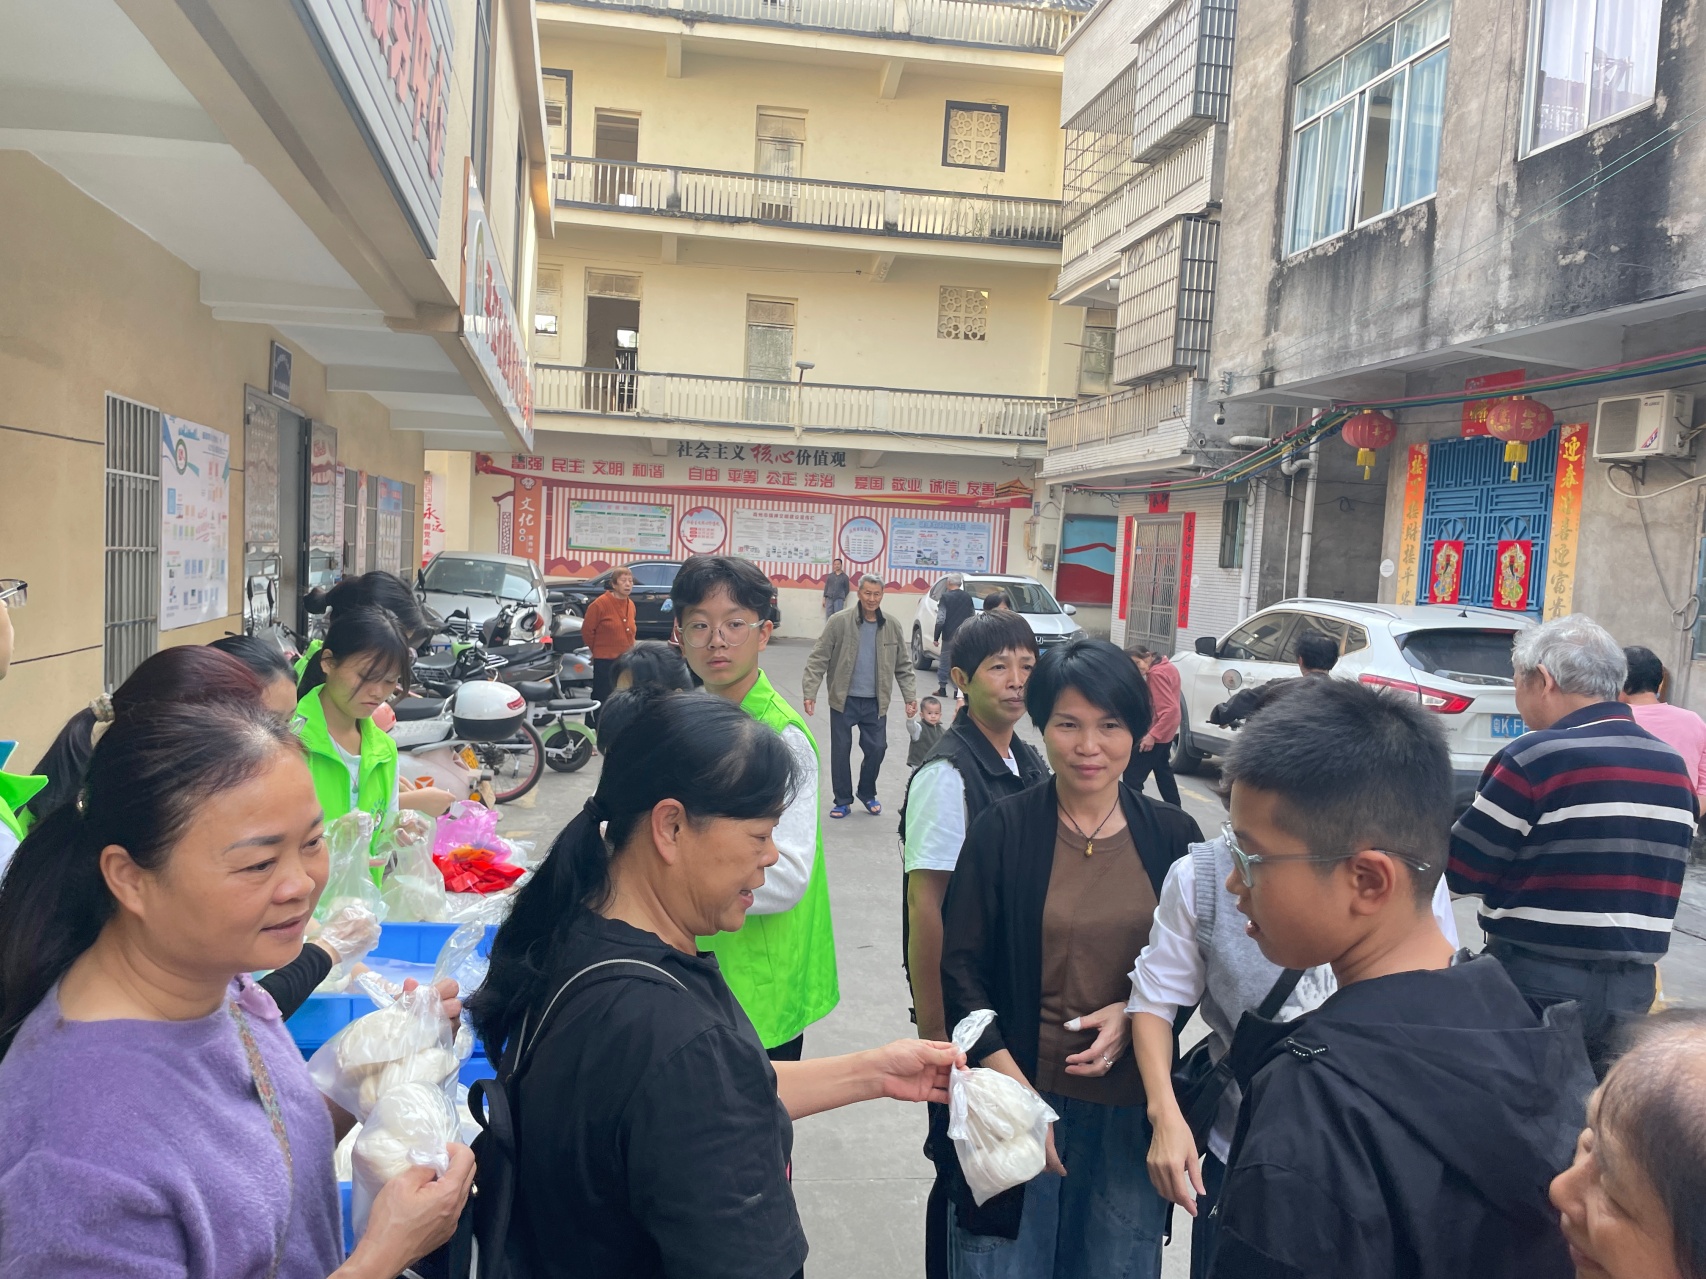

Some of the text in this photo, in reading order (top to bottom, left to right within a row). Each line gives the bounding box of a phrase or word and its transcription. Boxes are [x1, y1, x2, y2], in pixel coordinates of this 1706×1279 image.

[676, 440, 847, 468] 社会主义核心价值观
[511, 454, 997, 497] 富强 民主 文明 和谐 自由 平等 公正 法治 爱国 敬业 诚信 友善
[518, 497, 535, 527] 文化
